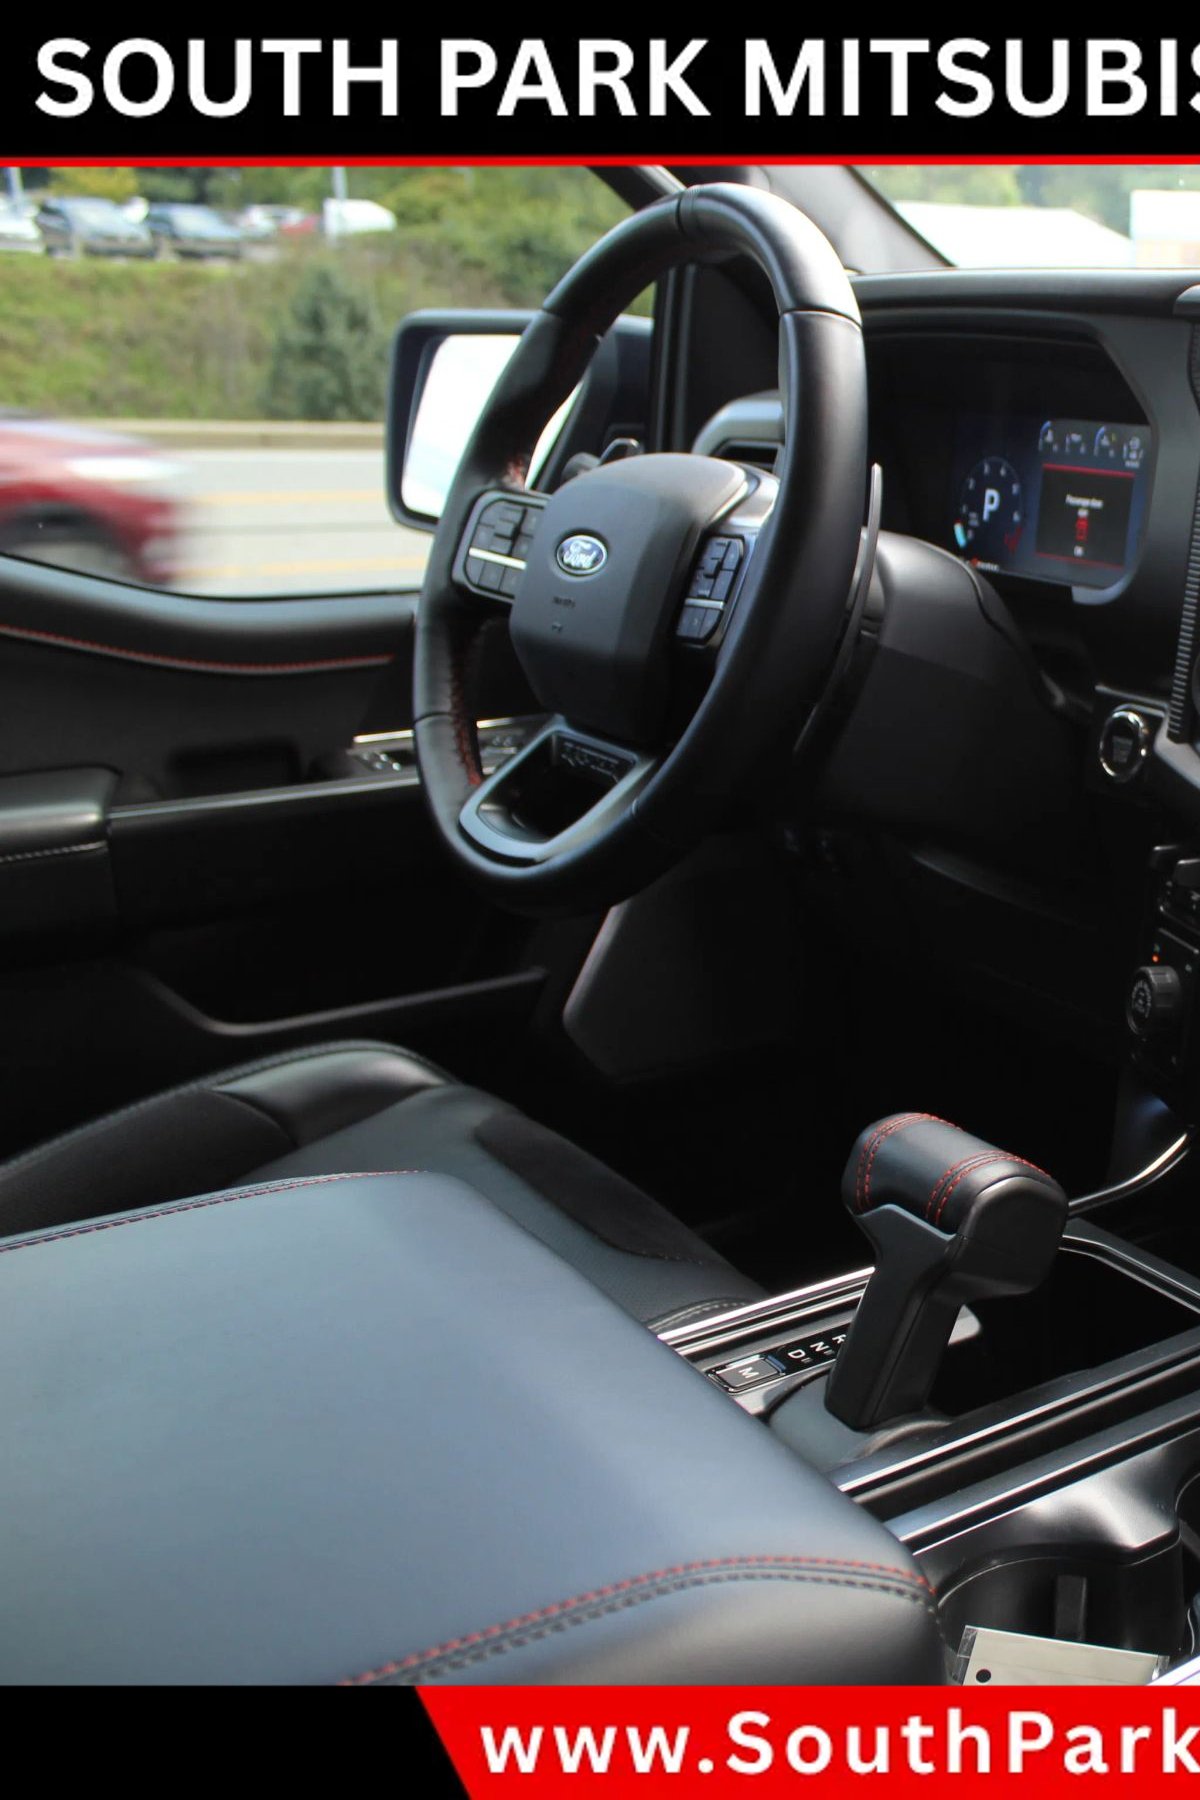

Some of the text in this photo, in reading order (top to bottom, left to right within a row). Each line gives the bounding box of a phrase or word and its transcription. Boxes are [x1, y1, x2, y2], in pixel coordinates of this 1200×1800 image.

[983, 488, 1000, 522] P
[563, 540, 597, 568] Ford
[810, 1341, 829, 1353] N
[788, 1349, 806, 1359] D
[739, 1367, 759, 1379] M
